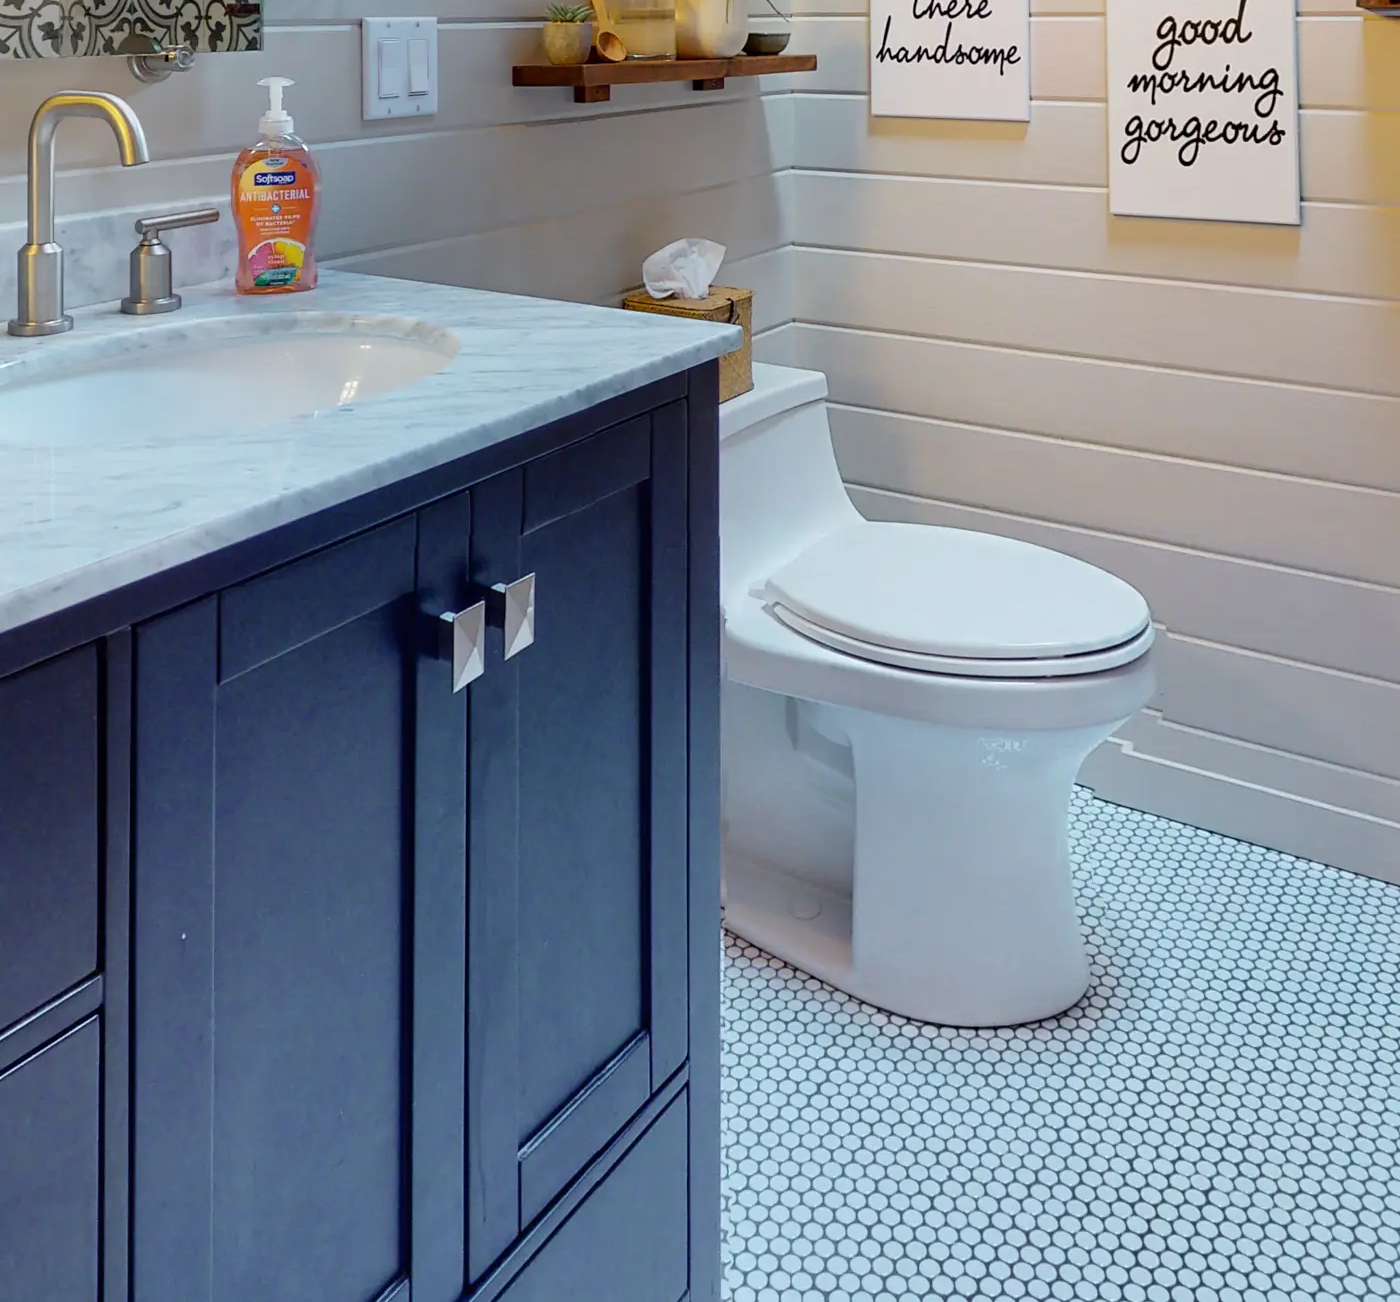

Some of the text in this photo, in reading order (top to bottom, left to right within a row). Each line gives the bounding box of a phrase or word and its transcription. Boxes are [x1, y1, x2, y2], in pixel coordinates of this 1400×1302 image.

[876, 15, 1021, 76] handsome
[1127, 64, 1284, 118] morning
[1121, 115, 1286, 167] gorgeous
[240, 188, 310, 202] ANTIBACTERIAL
[255, 173, 294, 185] Softsoap
